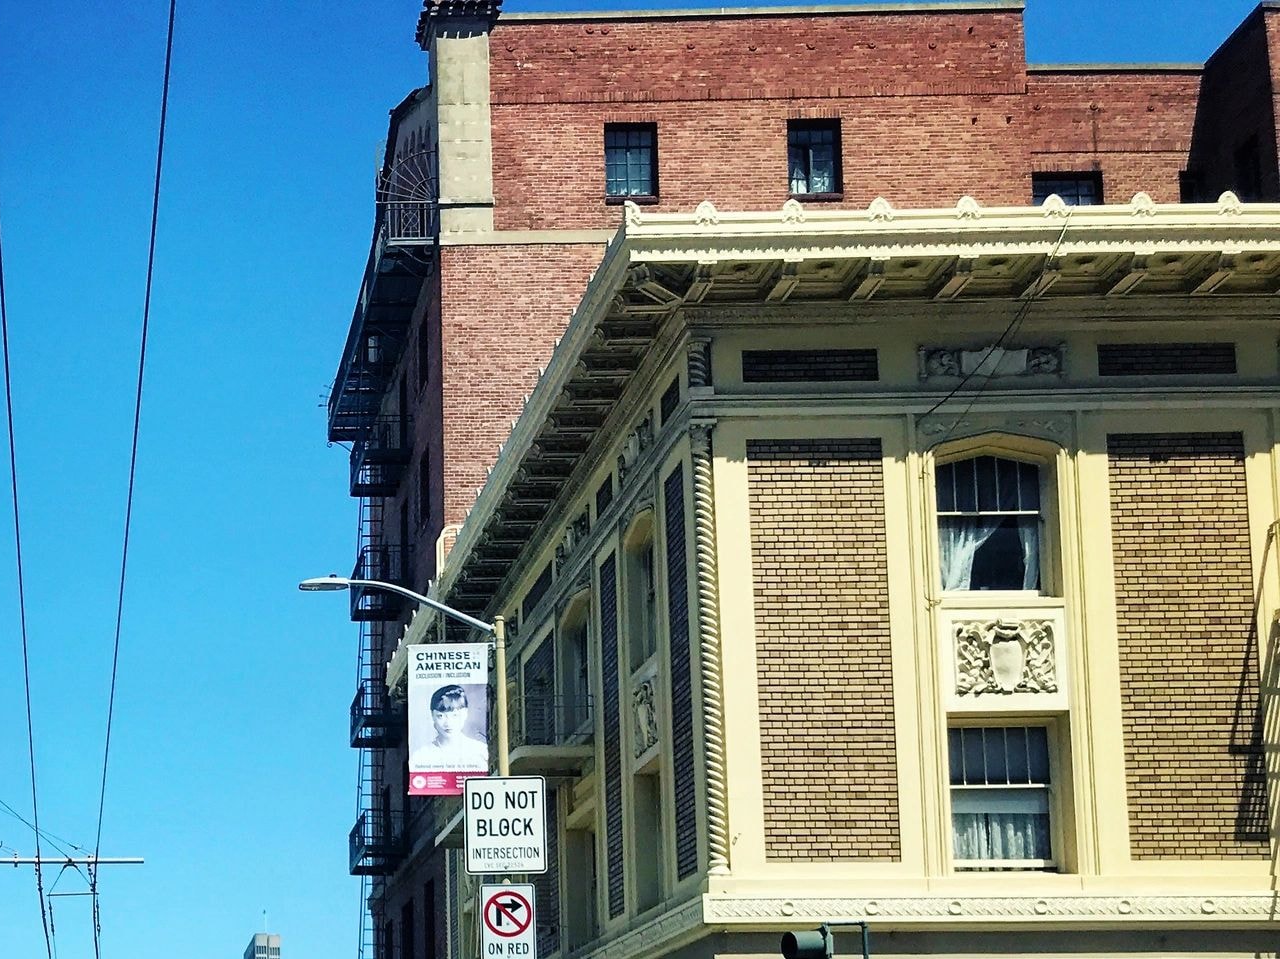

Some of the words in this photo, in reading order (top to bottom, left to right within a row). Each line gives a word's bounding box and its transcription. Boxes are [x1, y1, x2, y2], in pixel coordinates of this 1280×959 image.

[416, 651, 471, 661] CHINESE
[415, 662, 481, 671] AMERICAN
[471, 791, 494, 810] DO
[505, 790, 538, 809] NOT
[476, 818, 534, 837] BLOCK
[472, 846, 540, 859] INTERSECTION
[488, 942, 503, 955] ON
[508, 942, 529, 955] RED
